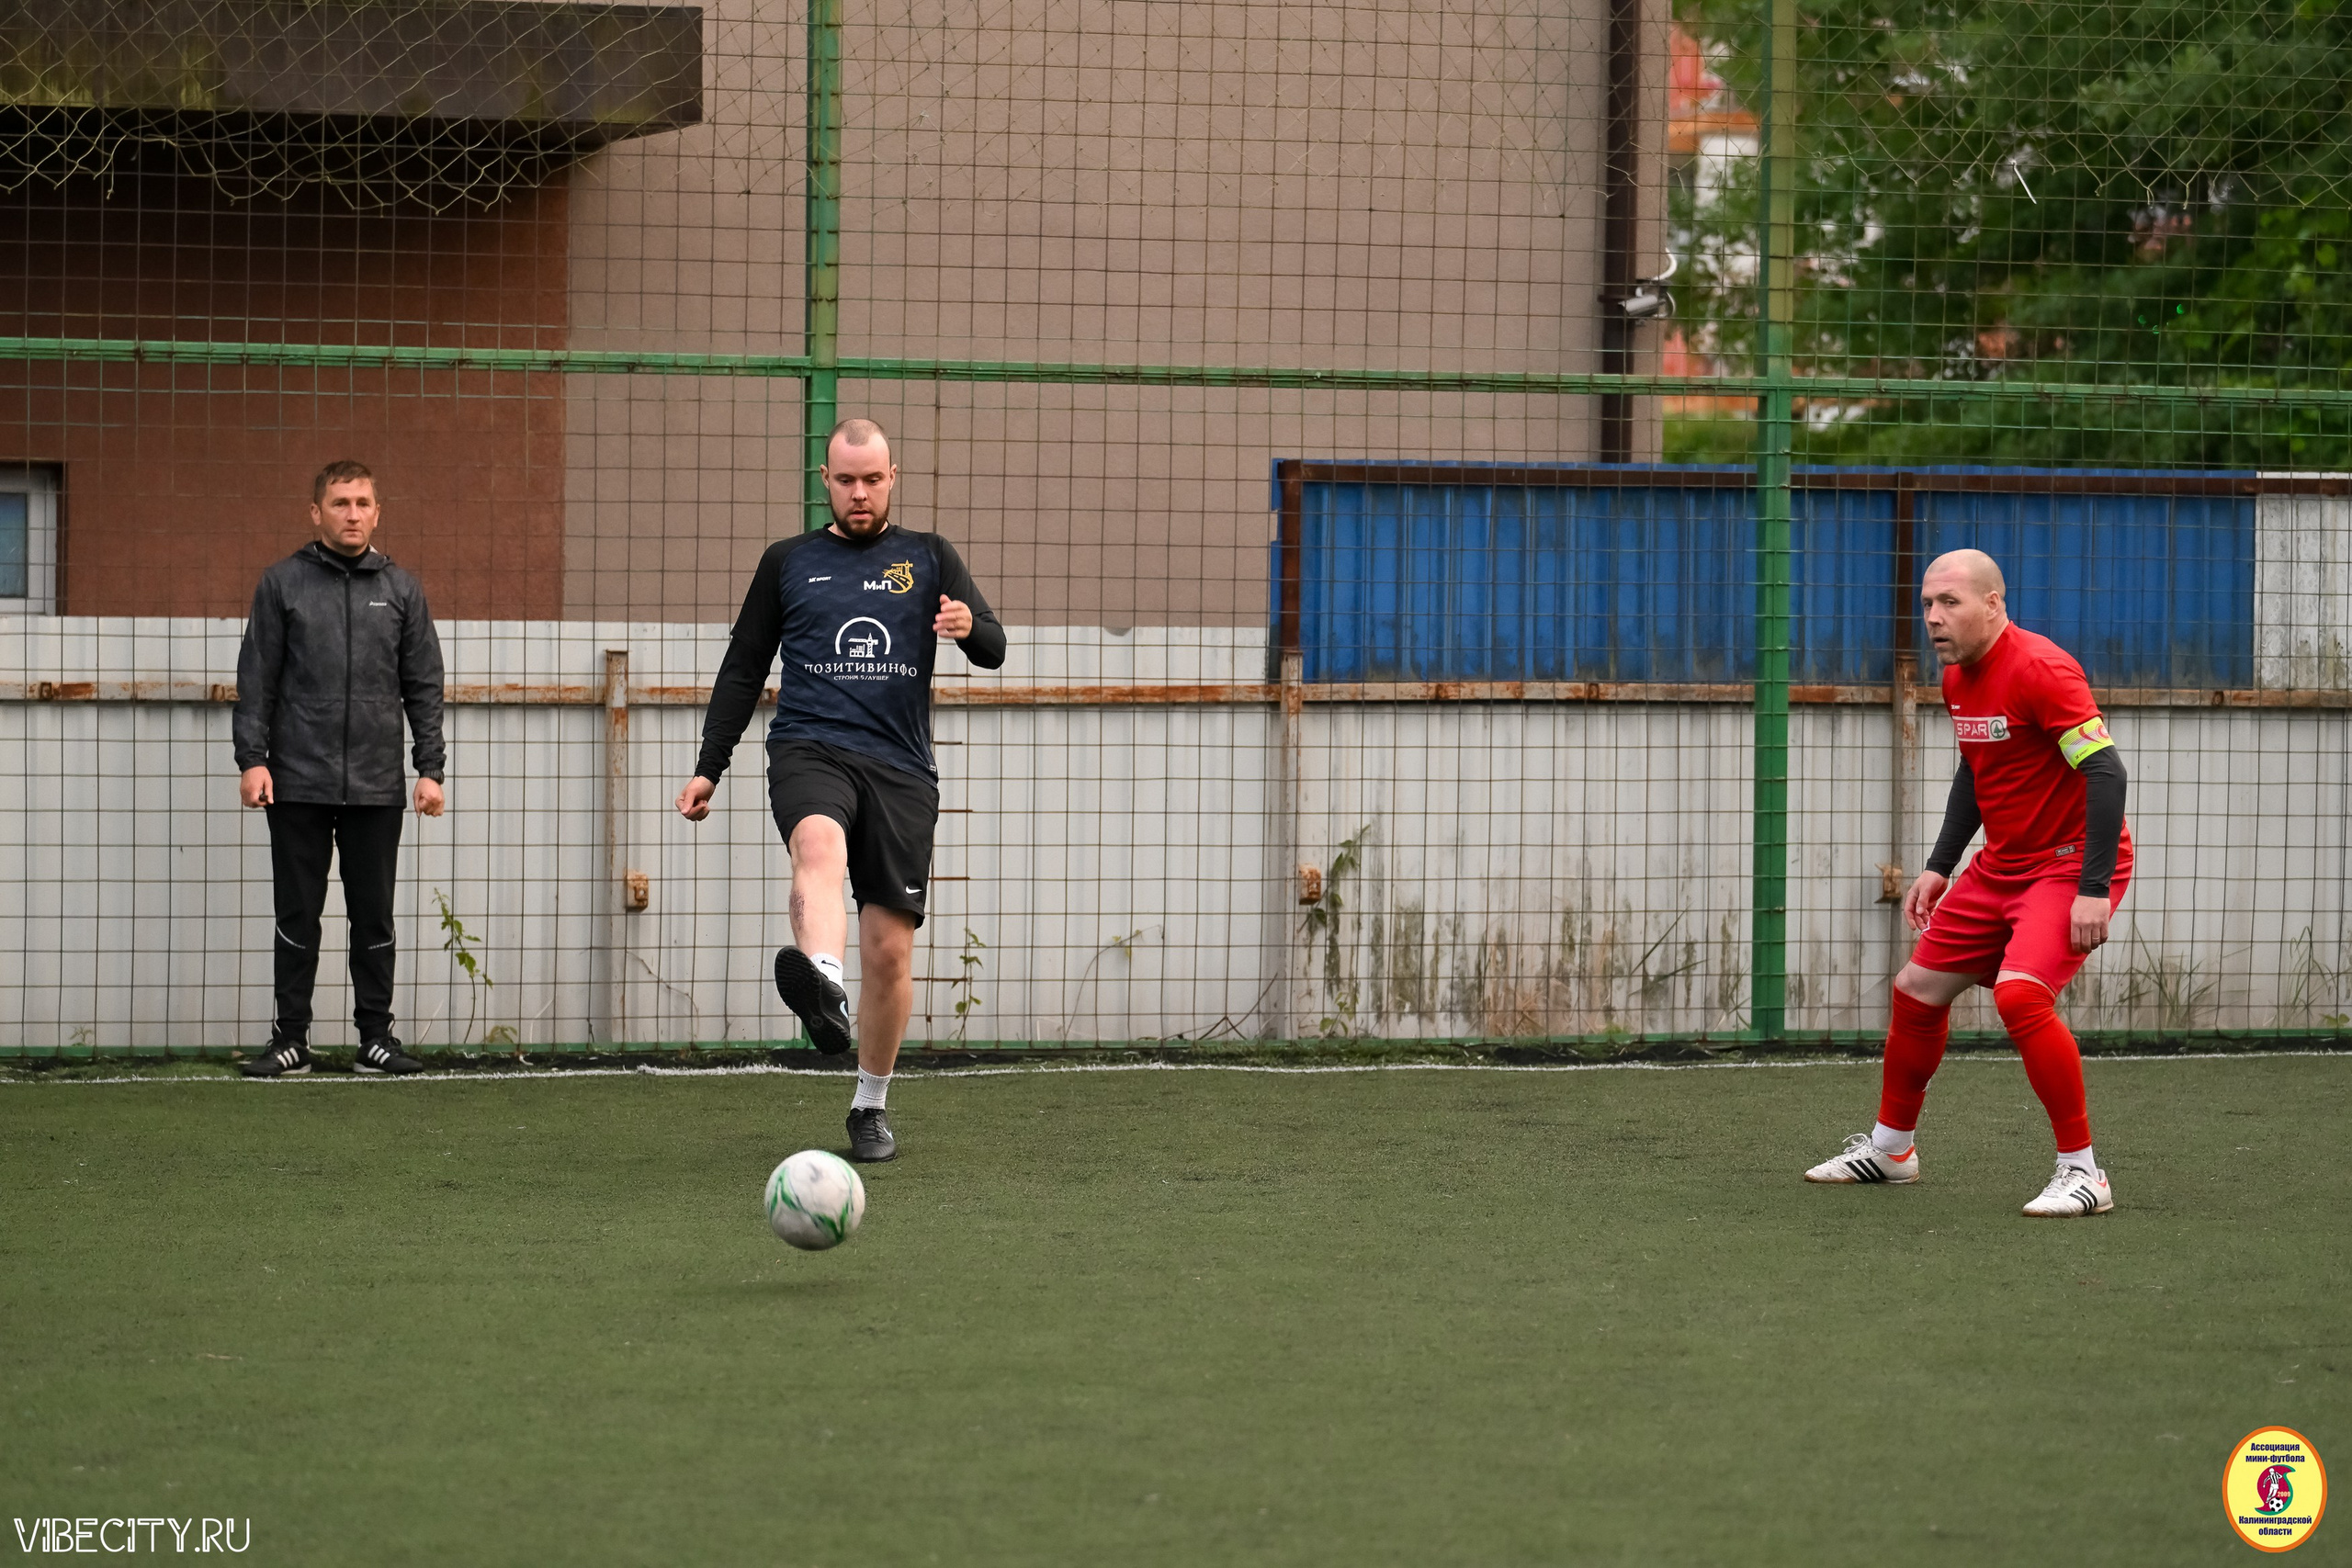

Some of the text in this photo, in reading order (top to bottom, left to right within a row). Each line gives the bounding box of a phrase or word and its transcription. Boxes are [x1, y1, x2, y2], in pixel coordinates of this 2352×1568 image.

[864, 581, 892, 591] МиП
[805, 662, 917, 677] ПОЗИТИВИНФО
[1956, 722, 1988, 737] SPAR
